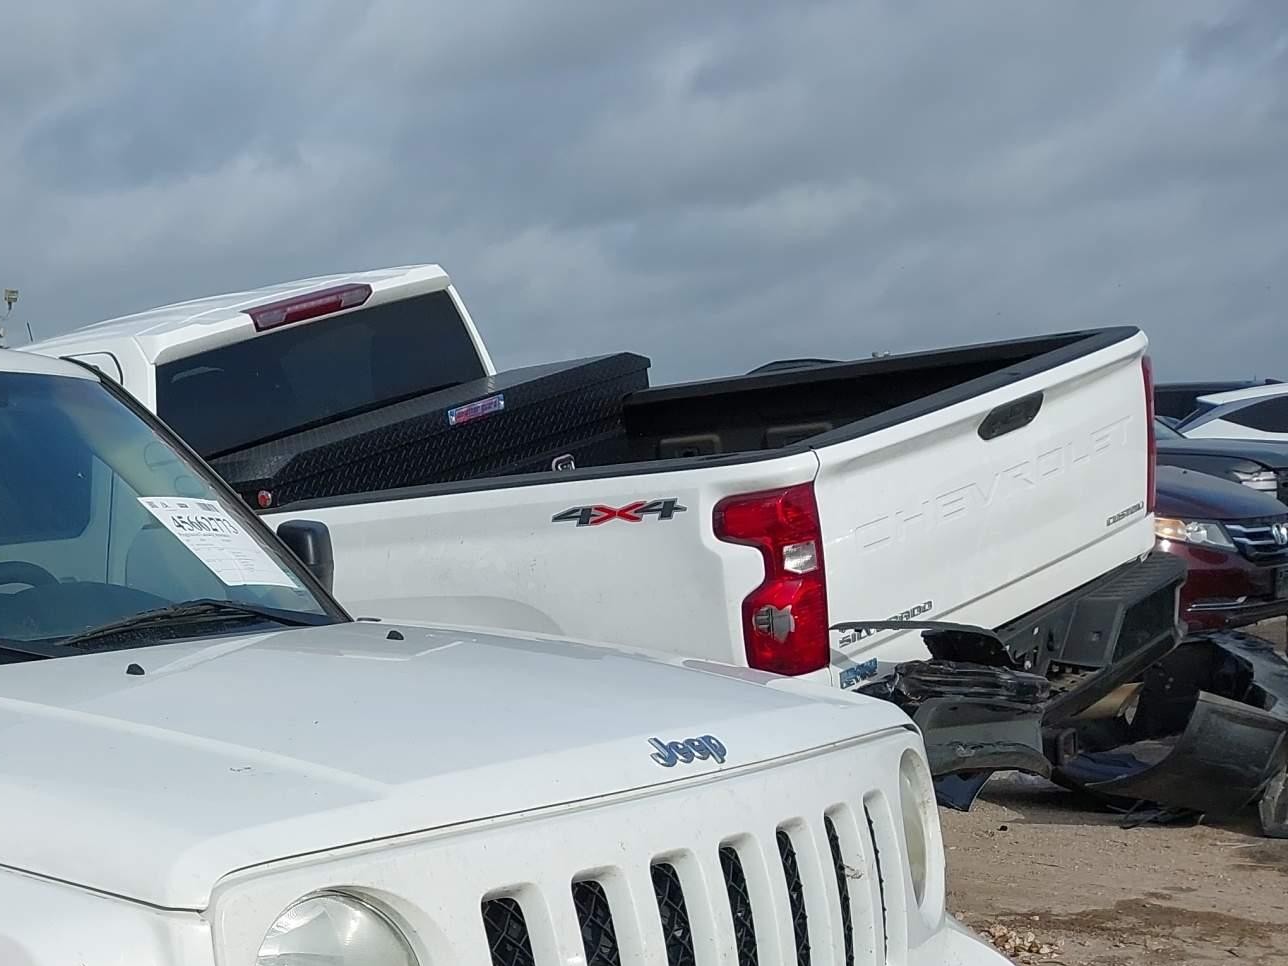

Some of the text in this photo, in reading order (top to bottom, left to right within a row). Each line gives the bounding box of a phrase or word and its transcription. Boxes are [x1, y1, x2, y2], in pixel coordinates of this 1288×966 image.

[854, 415, 1132, 550] CHEVROLET
[171, 516, 239, 535] 45662773
[838, 600, 933, 649] SILVADO
[647, 735, 727, 767] Jeep
